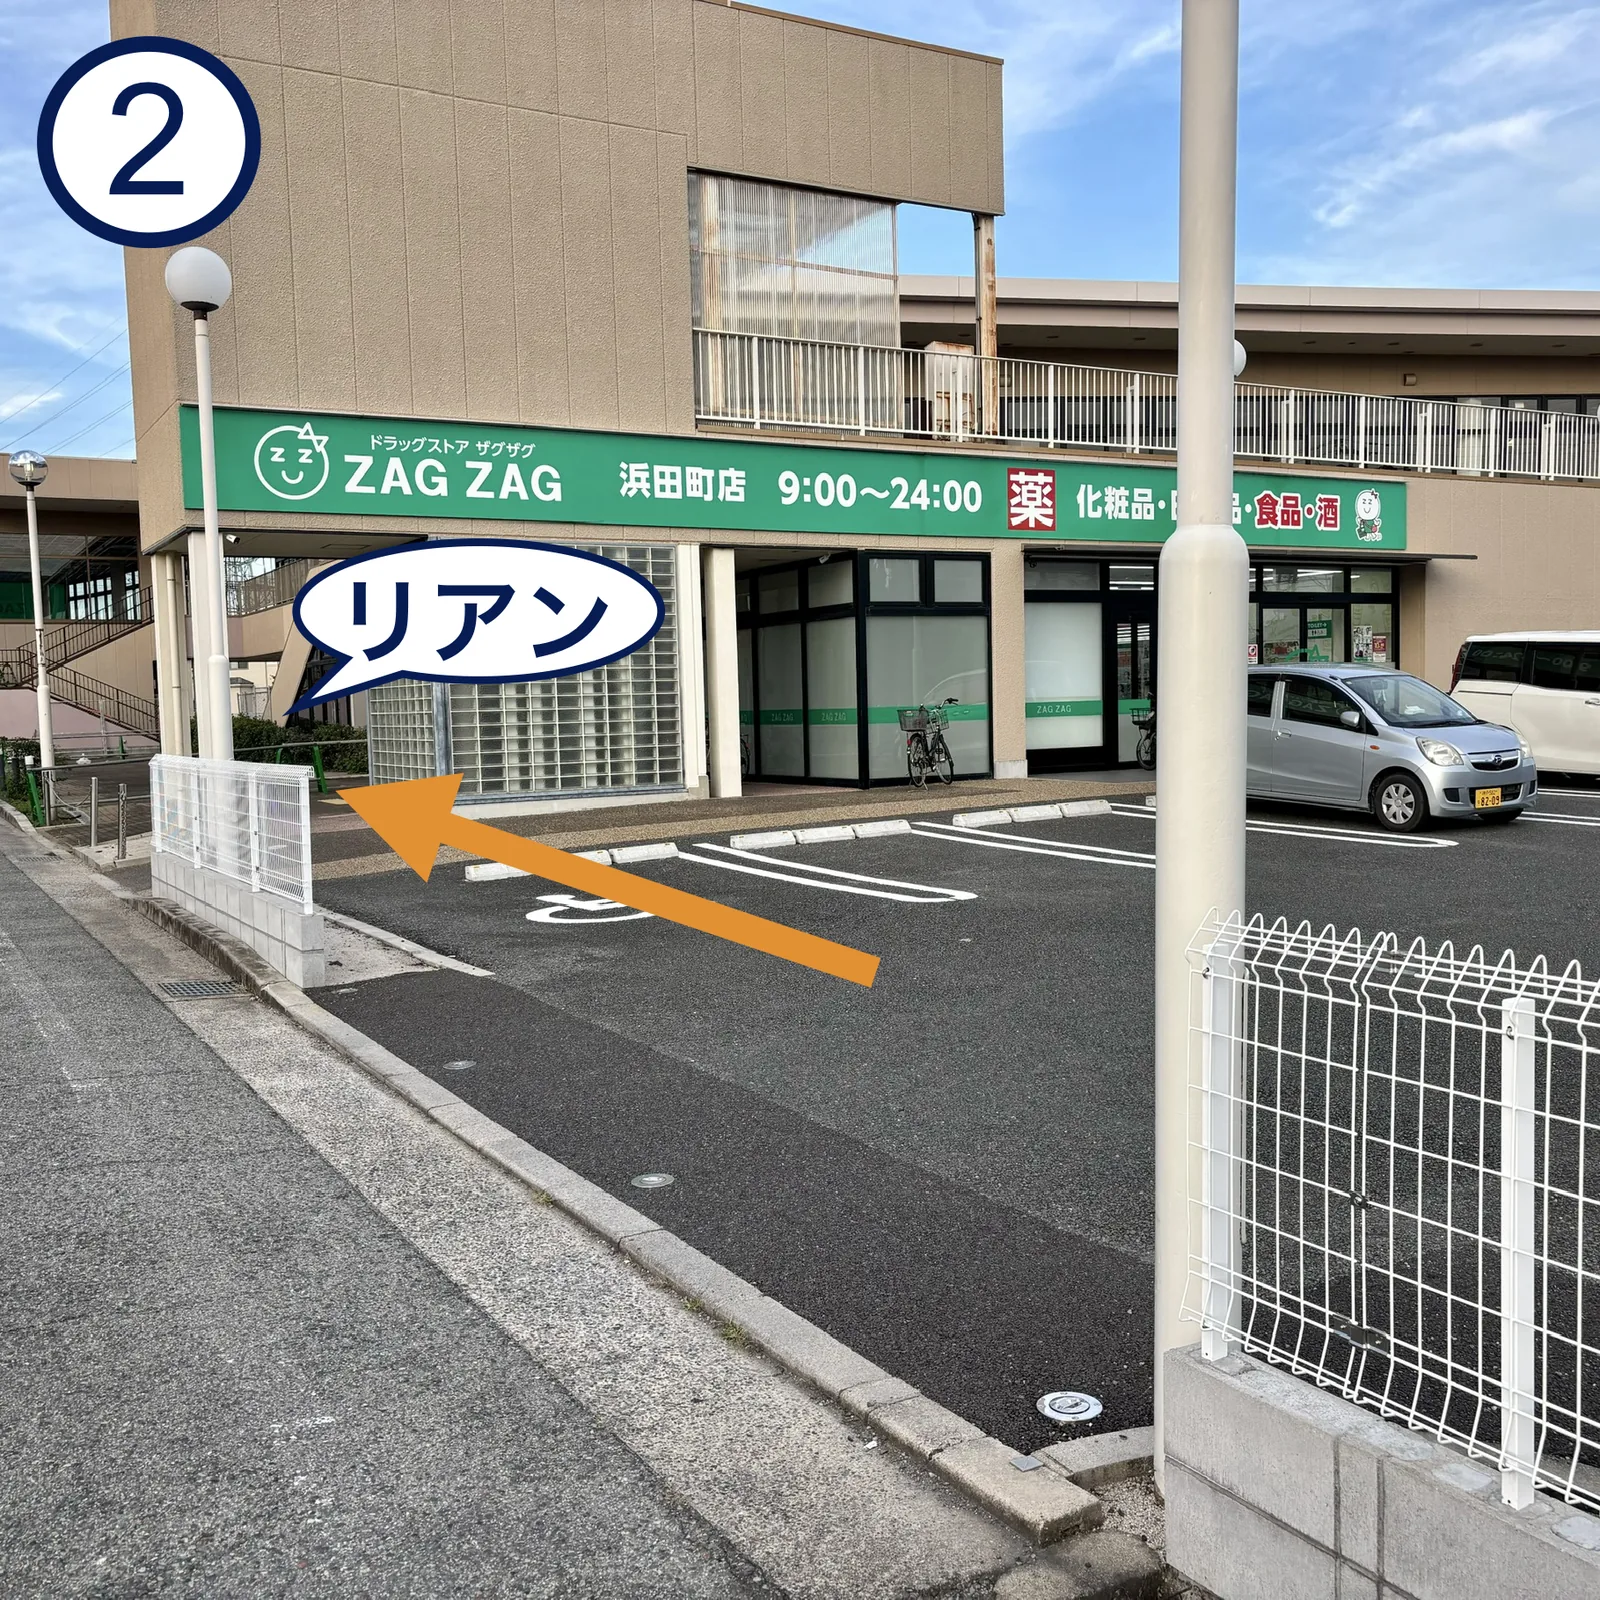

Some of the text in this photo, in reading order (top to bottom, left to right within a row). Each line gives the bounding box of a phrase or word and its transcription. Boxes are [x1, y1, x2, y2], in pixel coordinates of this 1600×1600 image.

[369, 434, 536, 459] ドラッグストア ザグザグ
[344, 455, 562, 503] ZAG ZAG
[619, 461, 746, 503] 浜田町店
[1010, 472, 1054, 528] 薬
[821, 711, 847, 722] ZAG ZAG
[1036, 704, 1072, 714] ZAG ZAG
[1480, 795, 1500, 807] 82-09
